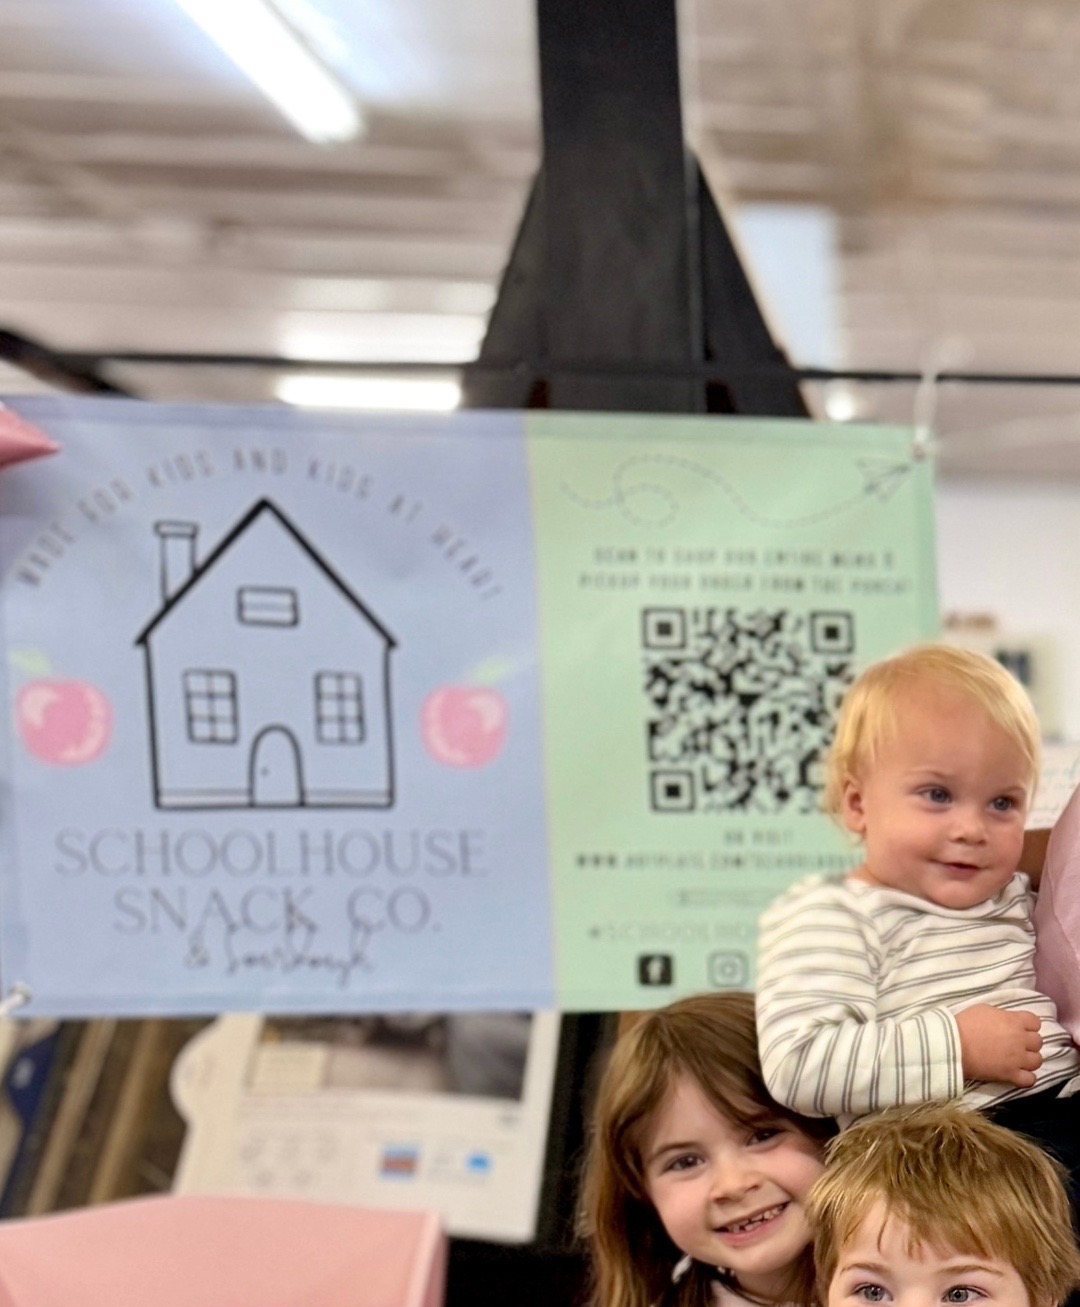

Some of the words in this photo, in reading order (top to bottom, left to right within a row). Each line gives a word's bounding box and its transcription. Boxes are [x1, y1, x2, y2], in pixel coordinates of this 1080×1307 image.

[148, 450, 215, 486] KIDS
[234, 449, 289, 475] AND
[307, 457, 375, 499] KIDS
[54, 828, 489, 878] SCHOOLHOUSE
[111, 884, 318, 935] SNACK
[346, 884, 443, 935] CO.
